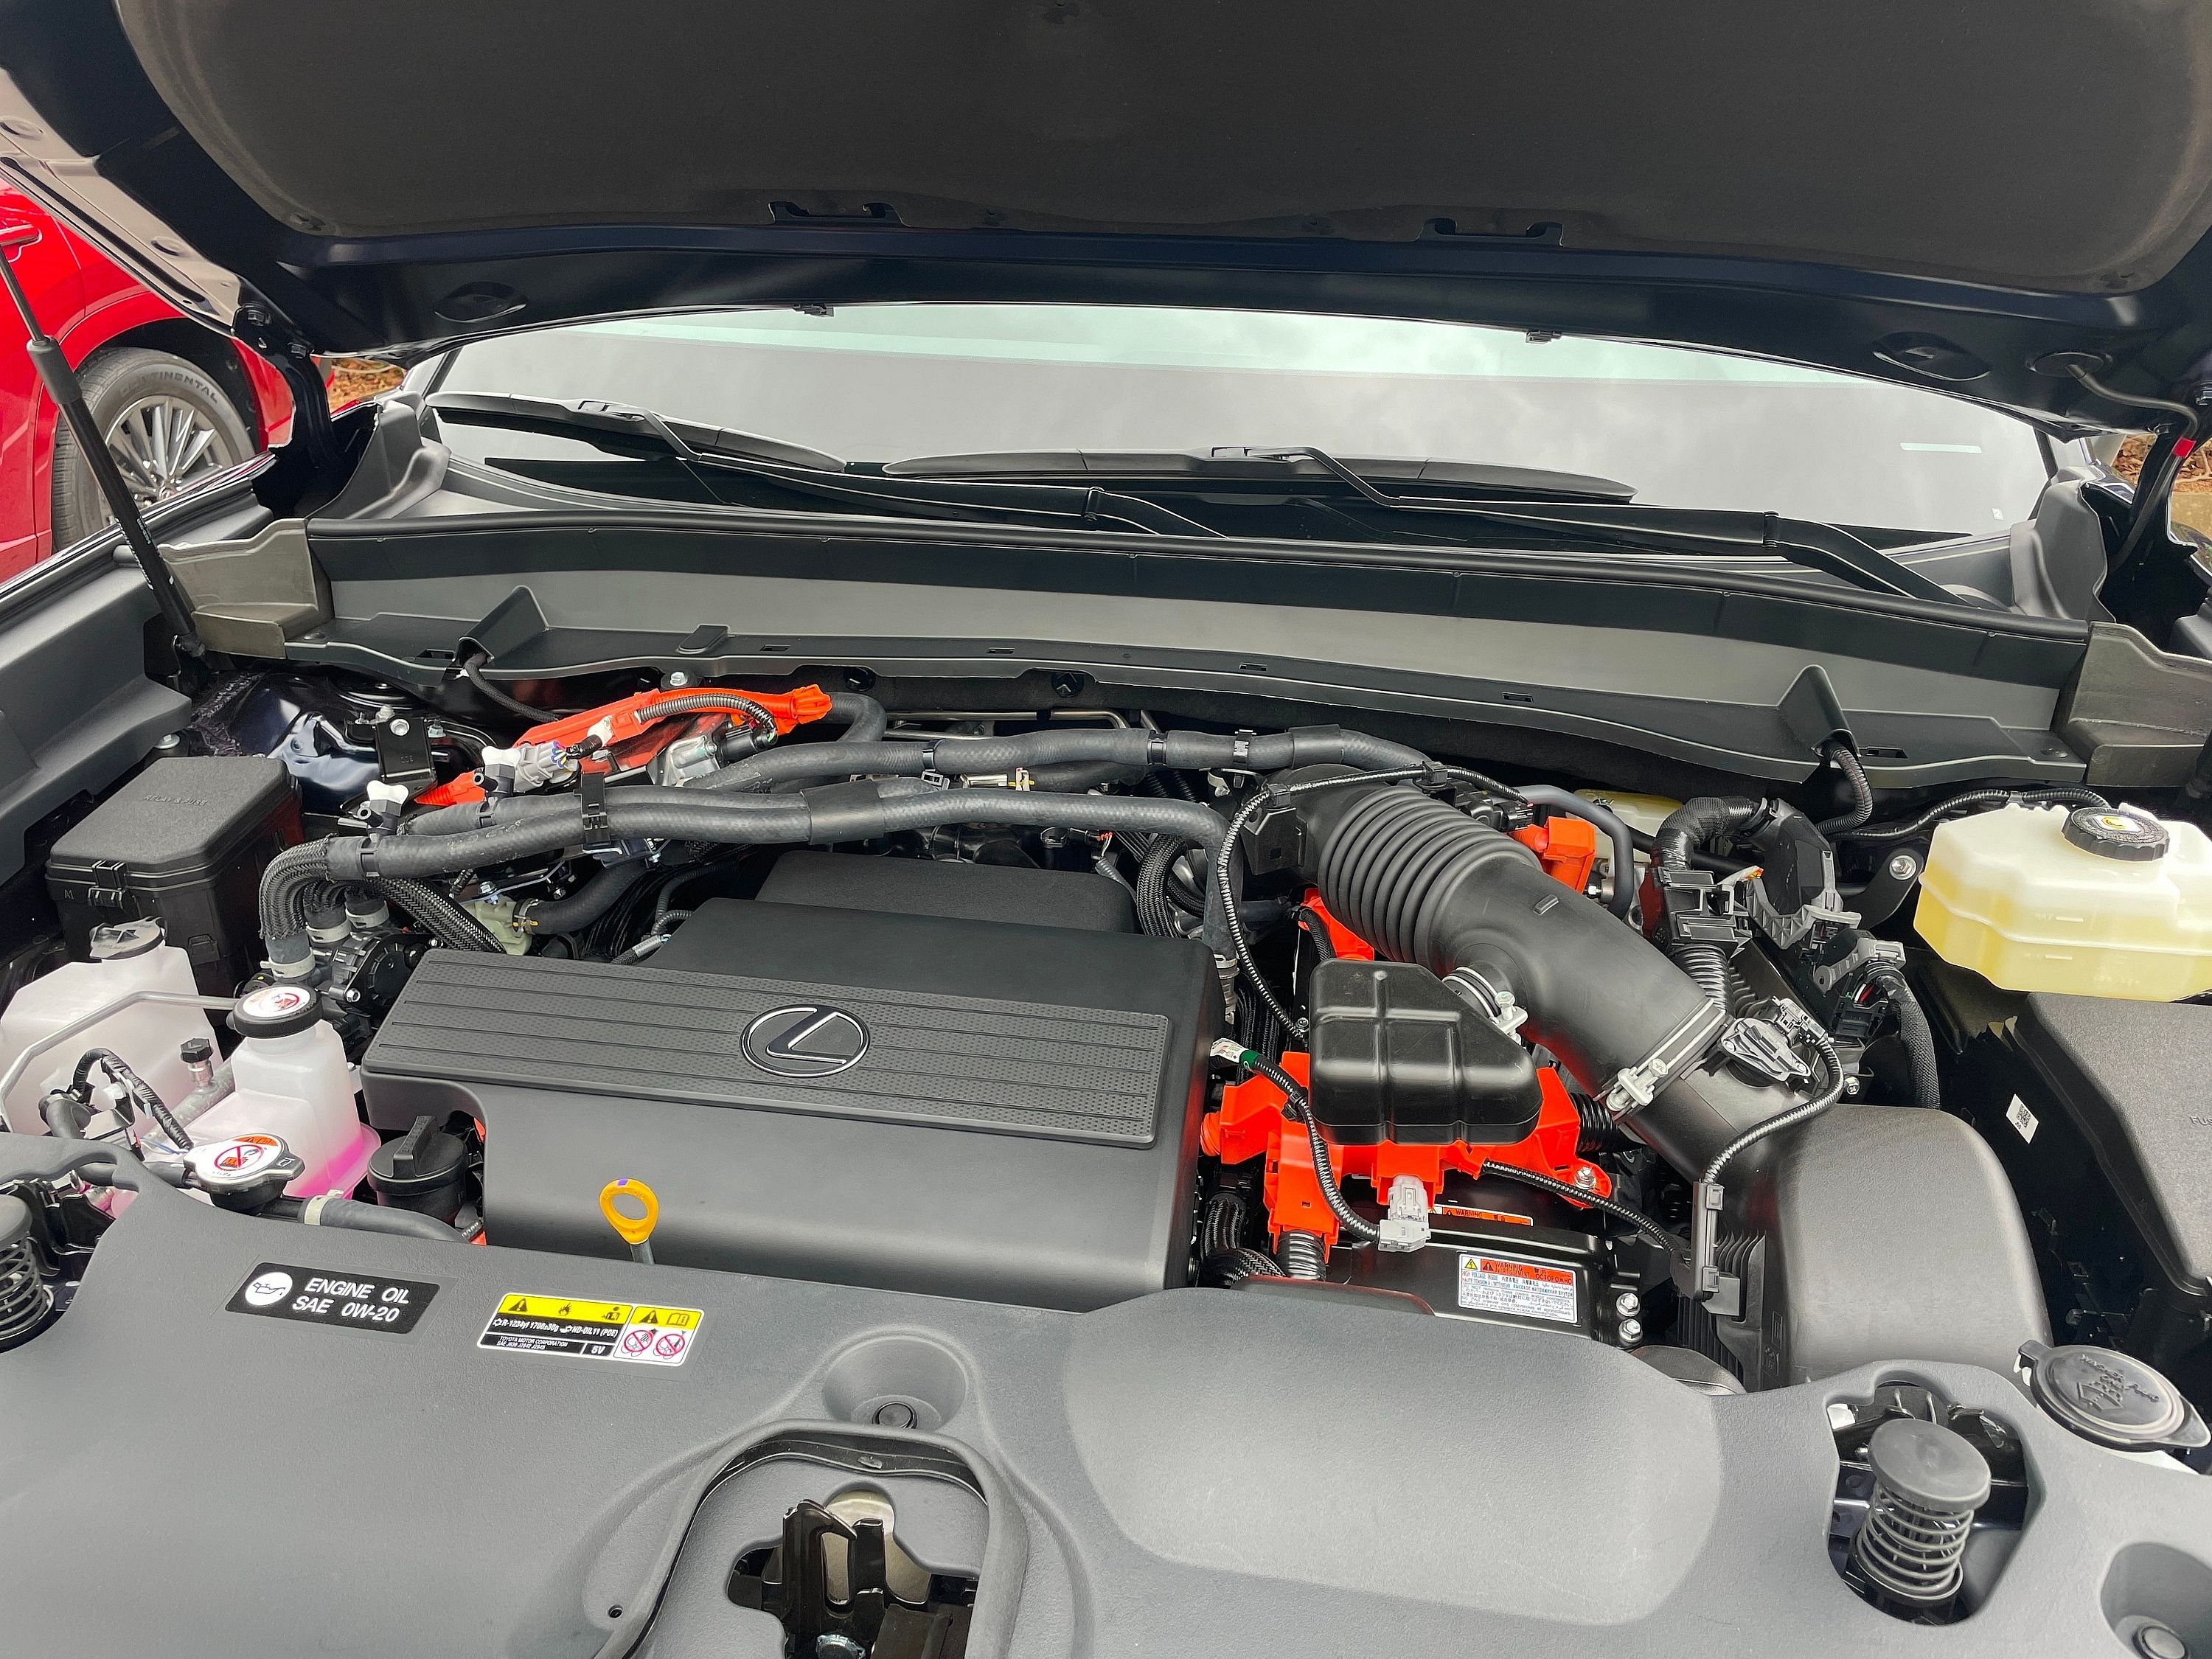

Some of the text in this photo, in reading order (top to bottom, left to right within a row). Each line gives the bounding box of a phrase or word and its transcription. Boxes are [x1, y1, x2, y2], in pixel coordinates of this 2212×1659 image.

[1455, 1209, 1483, 1218] WARNING
[1495, 1262, 1523, 1272] WARNING
[305, 1277, 410, 1304] ENGINE OIL
[292, 1295, 400, 1322] SAE 0W-20
[600, 1329, 618, 1338] (POE)
[535, 1339, 568, 1347] CORPORATION
